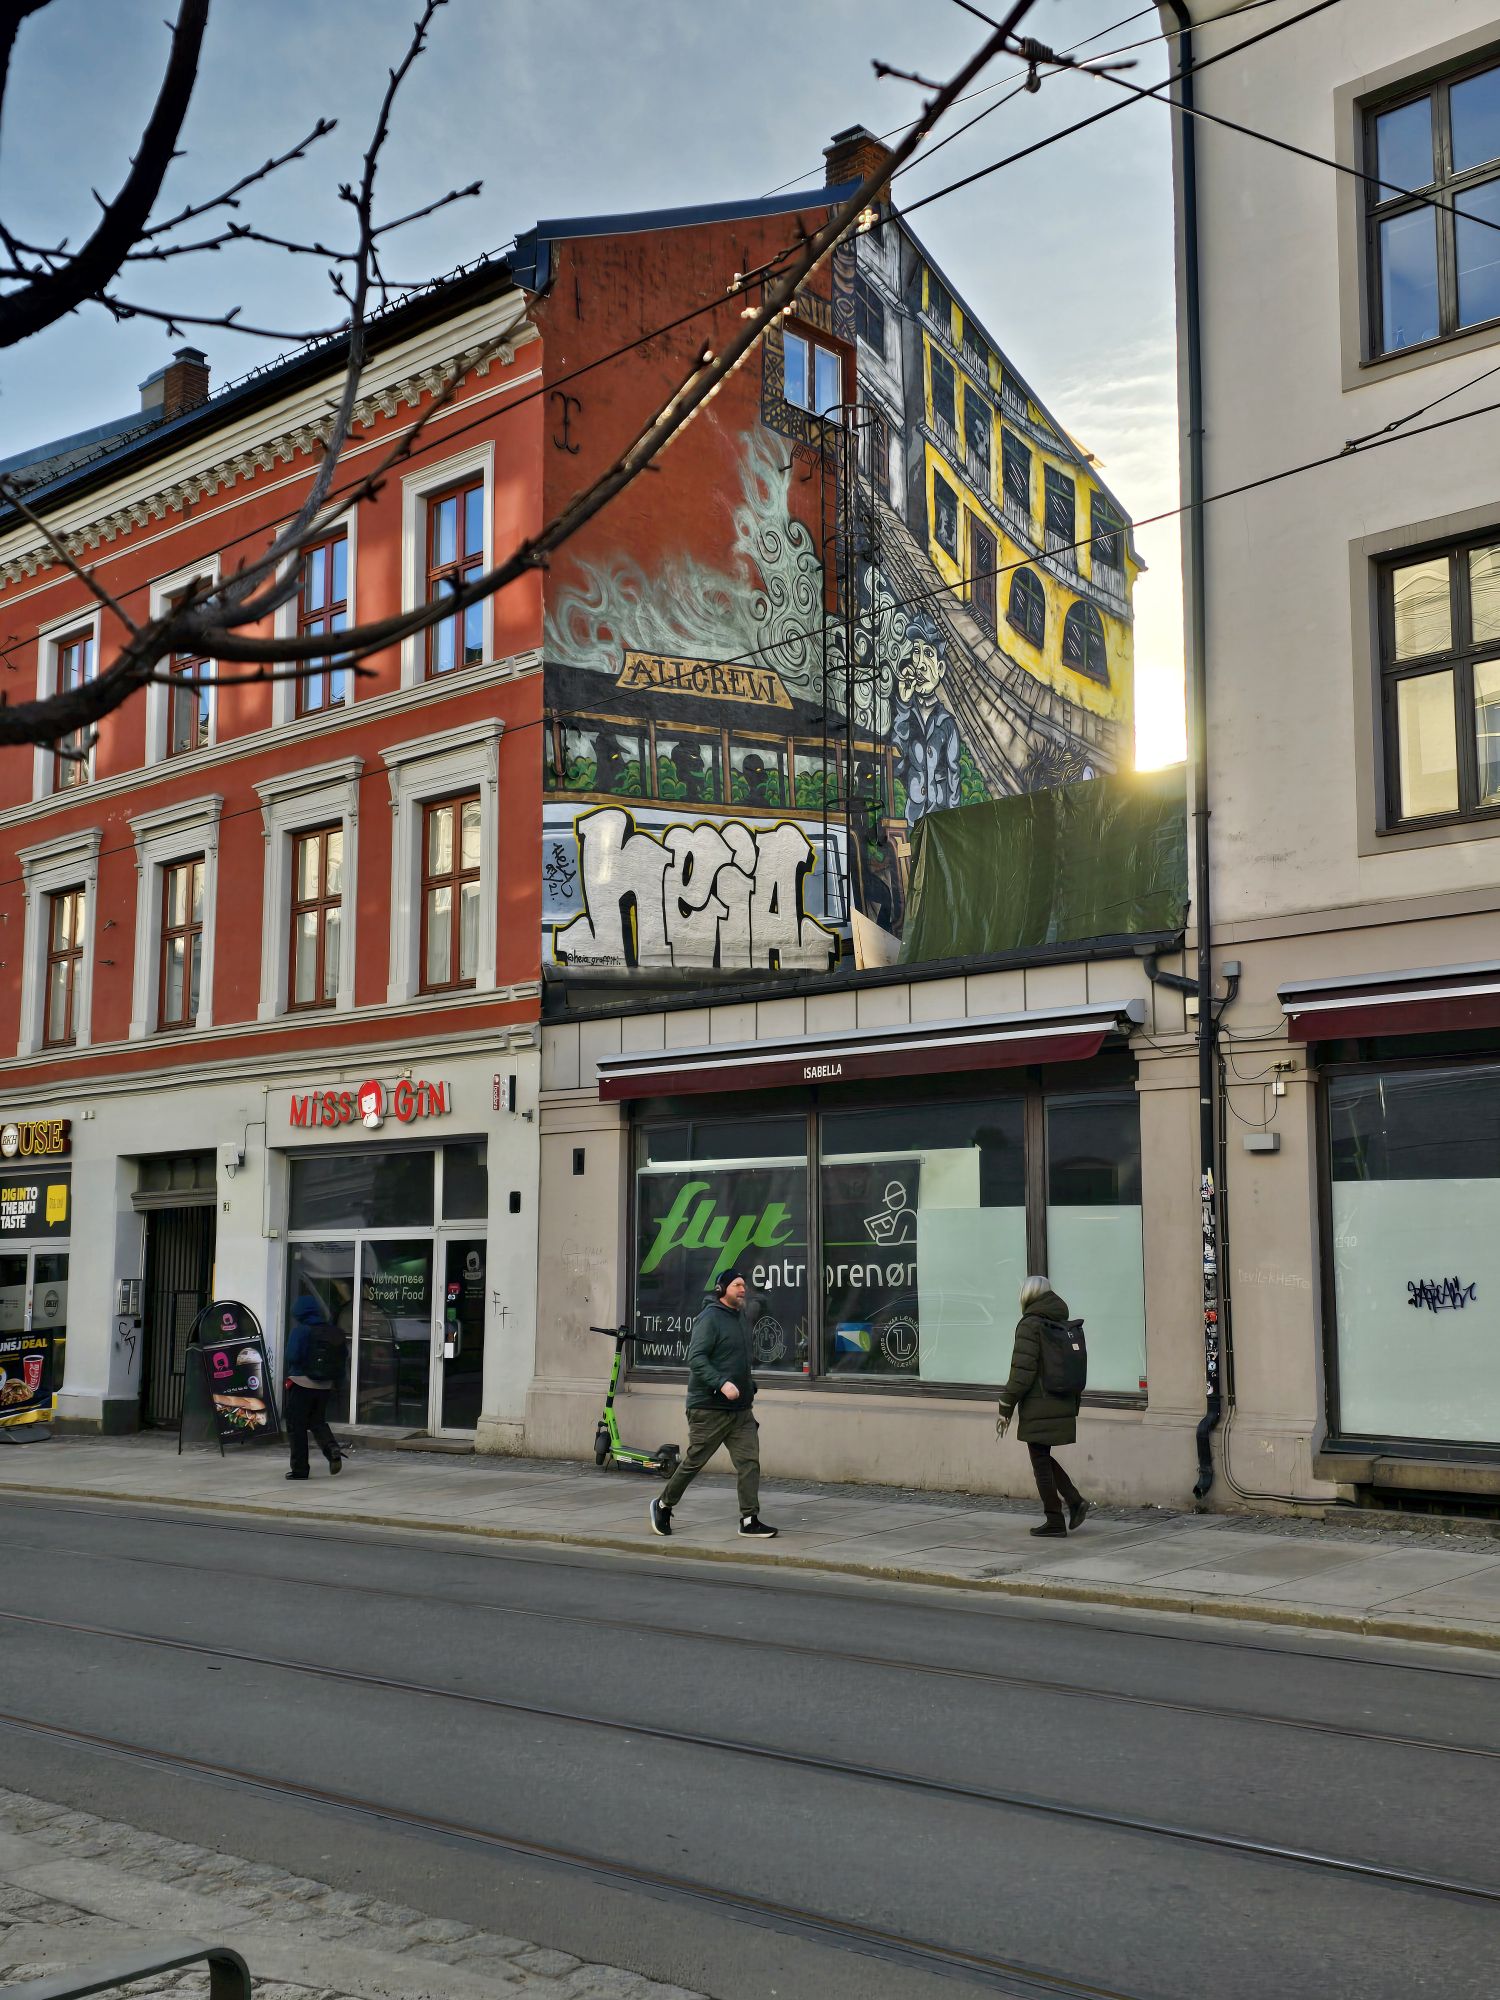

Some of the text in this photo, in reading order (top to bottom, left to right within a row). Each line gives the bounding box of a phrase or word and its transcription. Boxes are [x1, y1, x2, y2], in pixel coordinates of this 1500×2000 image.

[803, 1063, 842, 1079] ISABELLA
[2, 1188, 16, 1202] DIG
[1, 1201, 18, 1216] THE
[18, 1200, 36, 1214] BKH
[1, 1214, 26, 1230] TASTE
[639, 1181, 794, 1292] flyt
[370, 1271, 424, 1285] Vietnamese
[752, 1258, 918, 1295] entrprenør
[368, 1286, 424, 1301] Street Food
[666, 1316, 681, 1332] 24
[22, 1337, 48, 1350] DEAL
[642, 1340, 691, 1361] www.fly
